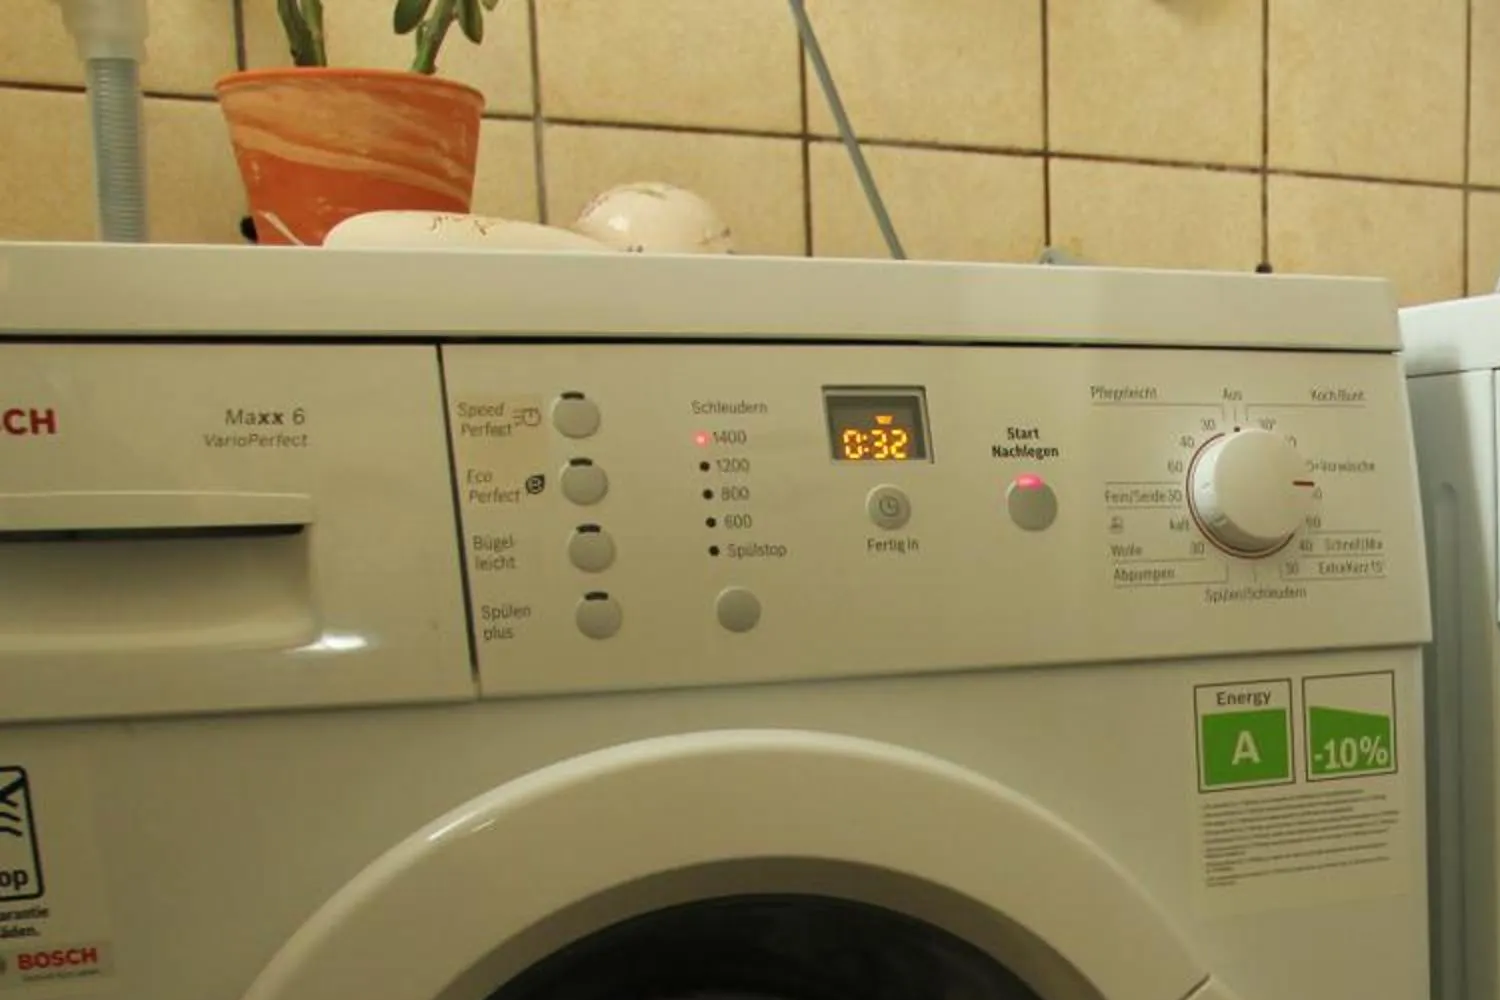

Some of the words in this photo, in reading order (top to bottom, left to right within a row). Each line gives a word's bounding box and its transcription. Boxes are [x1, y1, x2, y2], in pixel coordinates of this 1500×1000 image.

[456, 401, 505, 419] Speed
[691, 399, 768, 415] Schleudern
[0, 407, 56, 436] CH
[225, 408, 284, 425] Maxx
[292, 407, 305, 425] 6
[461, 421, 513, 438] Perfect
[712, 429, 748, 445] 1400
[1007, 427, 1040, 442] Start
[203, 433, 309, 448] VarioPerfect
[843, 429, 908, 460] 0:32
[991, 444, 1060, 461] Nachlegen
[717, 457, 751, 474] 1200
[466, 468, 493, 485] Eco
[469, 486, 521, 505] Perfect
[721, 485, 751, 501] 800
[472, 534, 515, 553] Bügel
[866, 538, 906, 554] Fertig
[907, 538, 919, 552] in
[475, 556, 517, 572] leicht
[480, 604, 532, 621] Spülen
[1215, 690, 1272, 706] Energy
[1231, 730, 1261, 766] A
[1314, 735, 1389, 770] -10%
[17, 947, 98, 971] BOSCH
